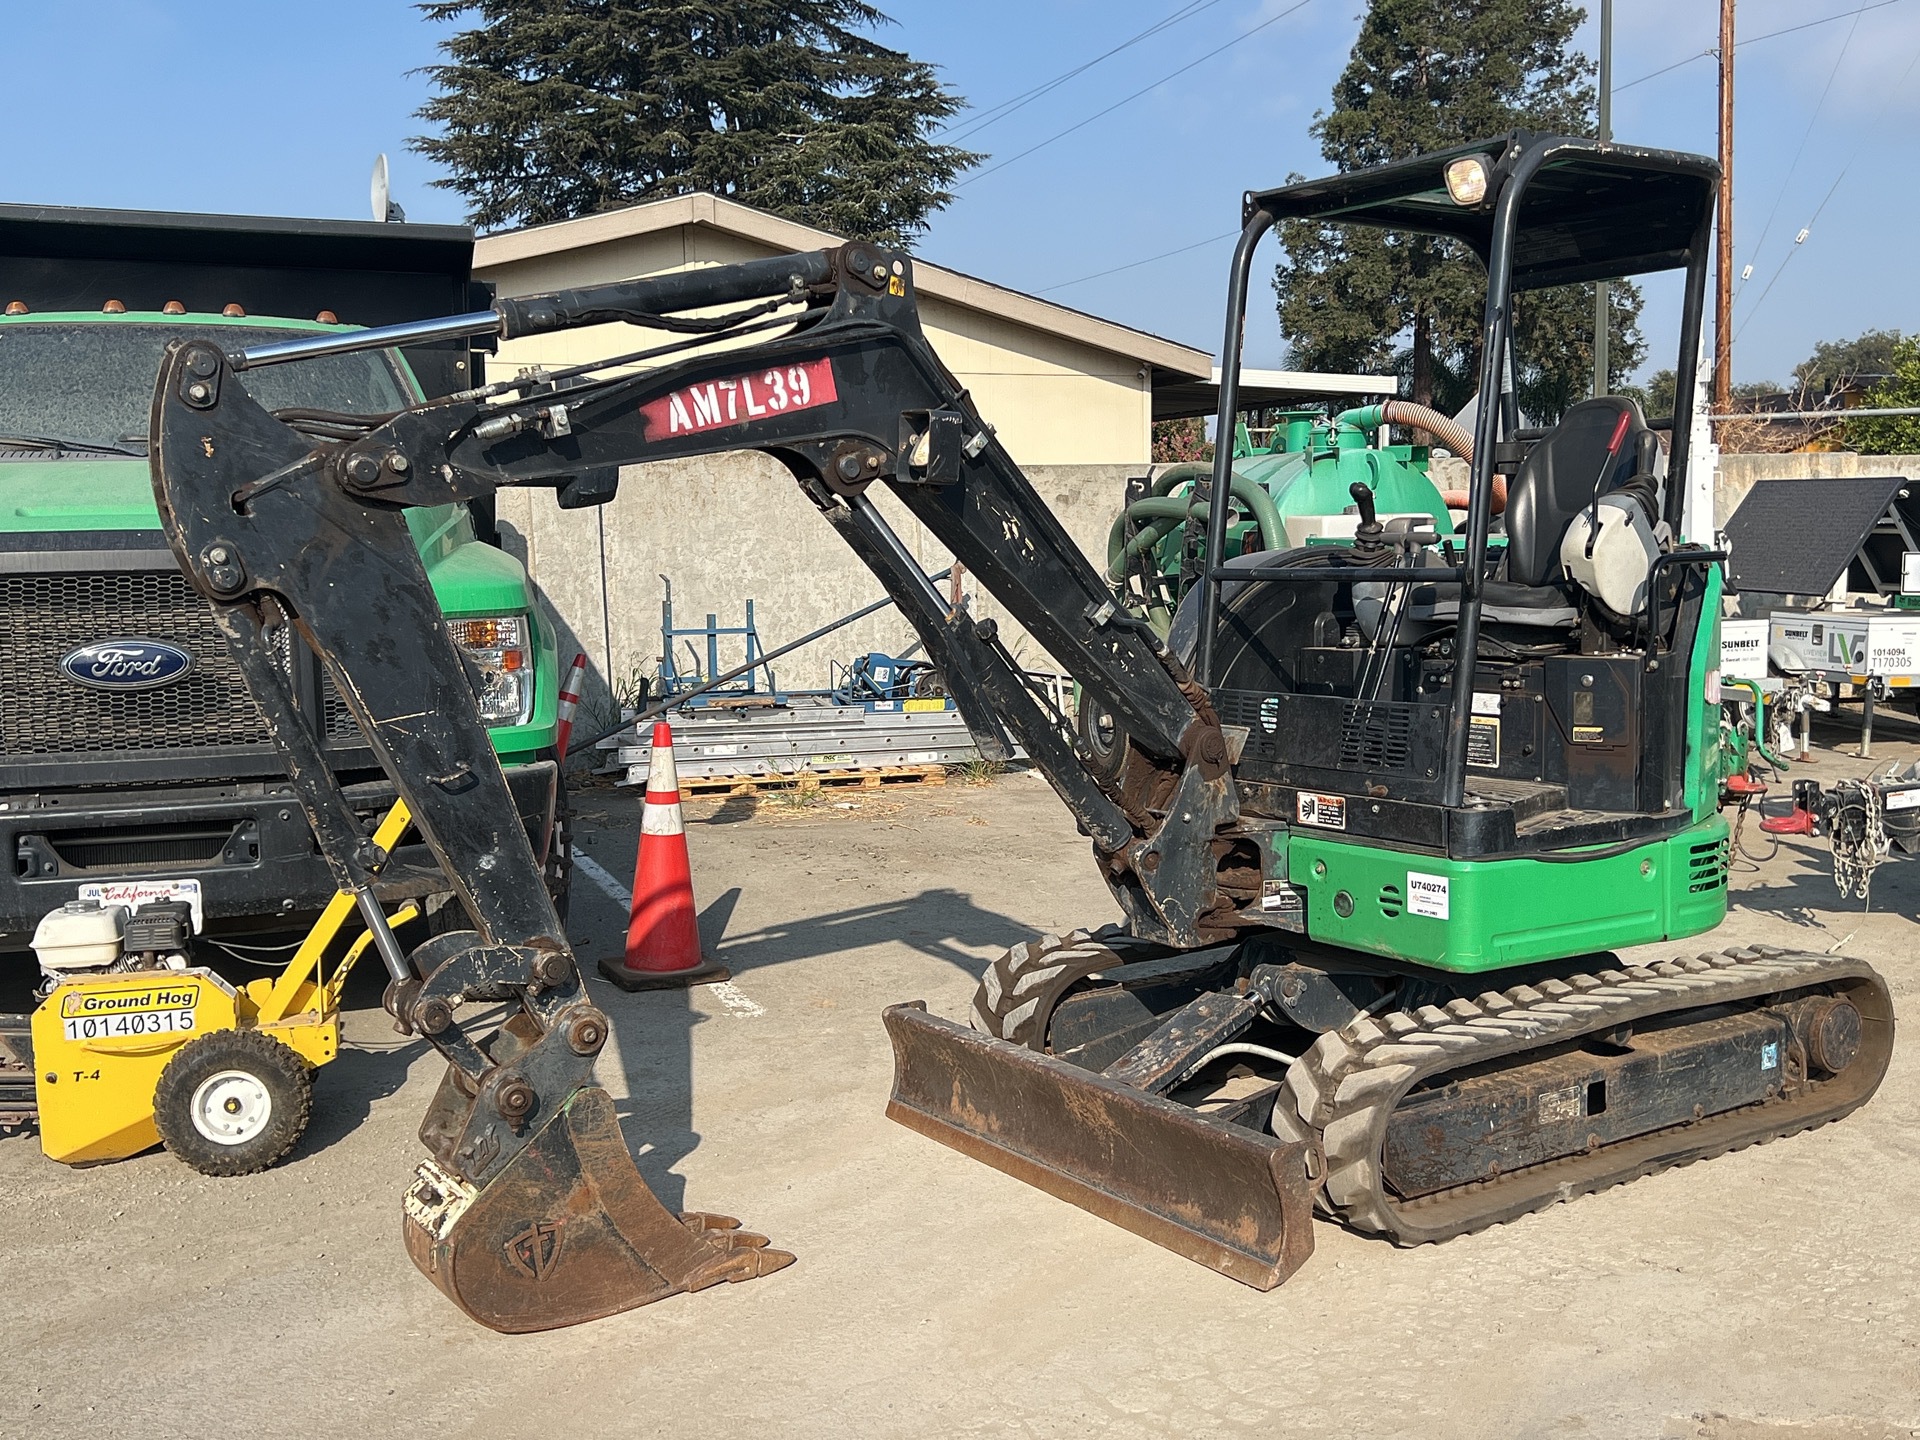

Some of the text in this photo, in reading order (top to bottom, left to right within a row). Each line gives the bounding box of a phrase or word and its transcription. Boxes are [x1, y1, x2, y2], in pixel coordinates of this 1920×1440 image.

[670, 366, 811, 433] AM7L39
[1721, 640, 1760, 649] SUNBELT
[1873, 648, 1905, 656] 1014094
[91, 649, 161, 677] Ford
[1872, 657, 1912, 667] T170305
[87, 889, 101, 897] JUL
[105, 886, 179, 903] California
[1411, 880, 1447, 894] U740274
[84, 992, 193, 1010] Ground Hog
[68, 1011, 193, 1039] 10140315
[73, 1069, 100, 1082] T-4
